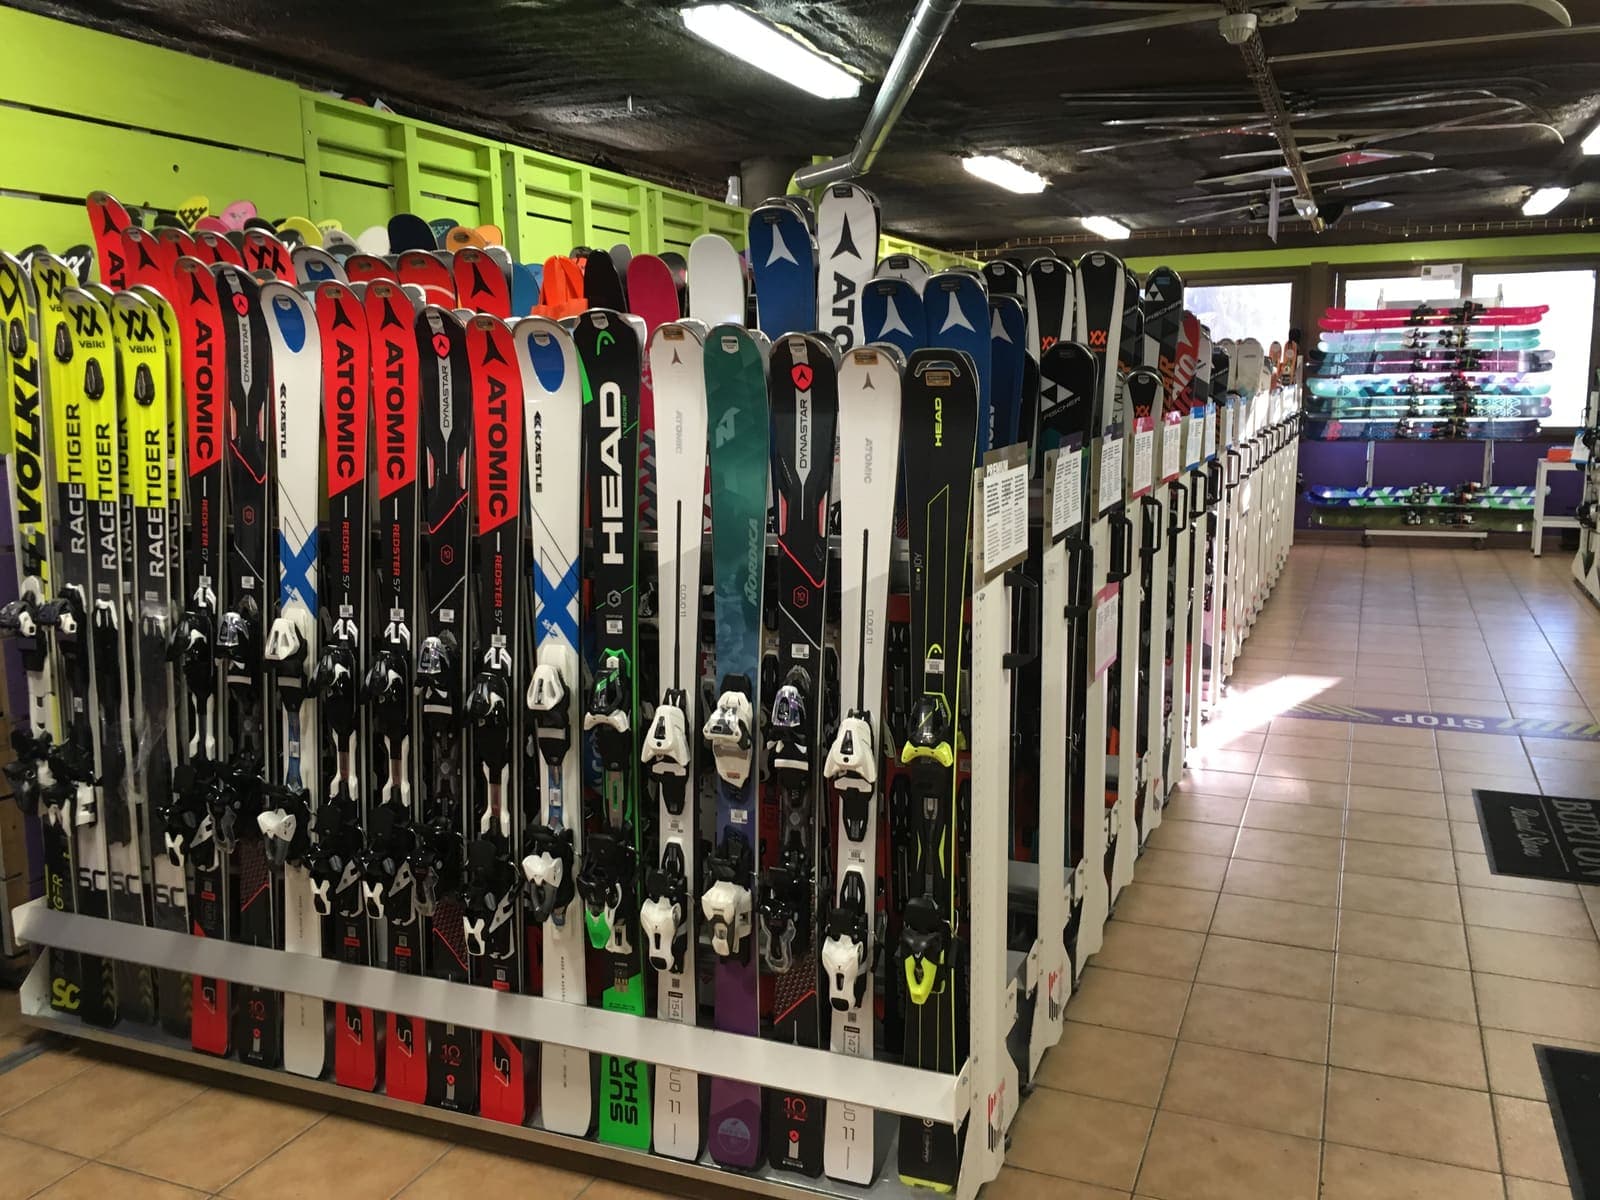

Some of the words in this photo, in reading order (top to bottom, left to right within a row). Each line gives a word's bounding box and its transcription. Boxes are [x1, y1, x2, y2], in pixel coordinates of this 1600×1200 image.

[243, 323, 252, 383] DYNASTAR
[195, 319, 213, 460] ATOMIC
[336, 340, 355, 479] ATOMIC
[385, 340, 405, 480] ATOMIC
[487, 375, 508, 518] ATOMIC
[799, 398, 808, 469] DYNASTAR
[934, 397, 943, 447] HEAD
[600, 381, 624, 564] HEAD
[864, 437, 873, 485] ATOMIC
[342, 521, 350, 574] REDSTER
[392, 524, 400, 576] REDSTER
[743, 517, 759, 607] NORDICA
[494, 555, 503, 608] REDSTER
[1392, 714, 1485, 730] STOP
[52, 977, 81, 1010] SC
[397, 1029, 412, 1058] S7
[494, 1056, 509, 1087] S7
